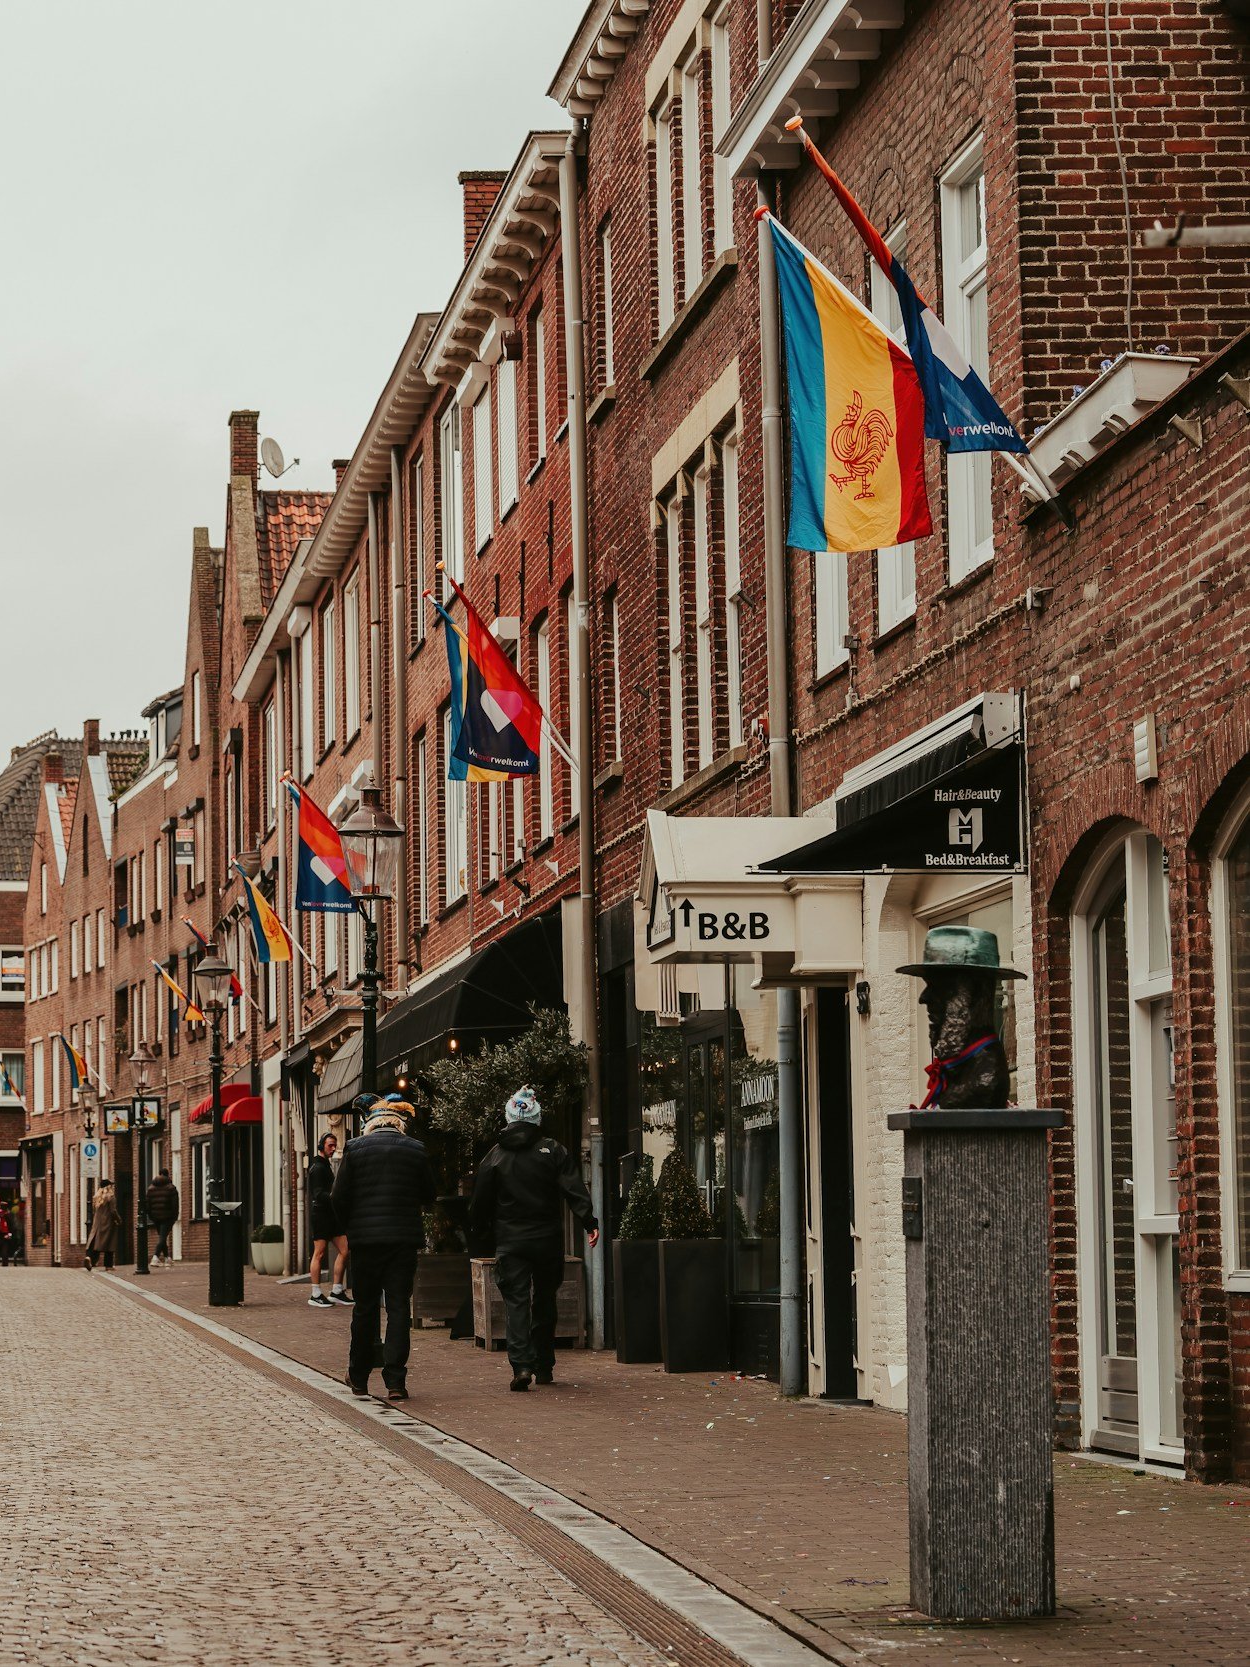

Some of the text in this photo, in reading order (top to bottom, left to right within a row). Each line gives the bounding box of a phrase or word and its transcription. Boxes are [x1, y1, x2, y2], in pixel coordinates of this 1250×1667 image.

[934, 788, 1002, 803] Hair&Beauty
[925, 852, 1010, 866] Bed&Breakfast
[698, 912, 770, 940] B&B
[740, 1074, 775, 1108] ANNAMOON
